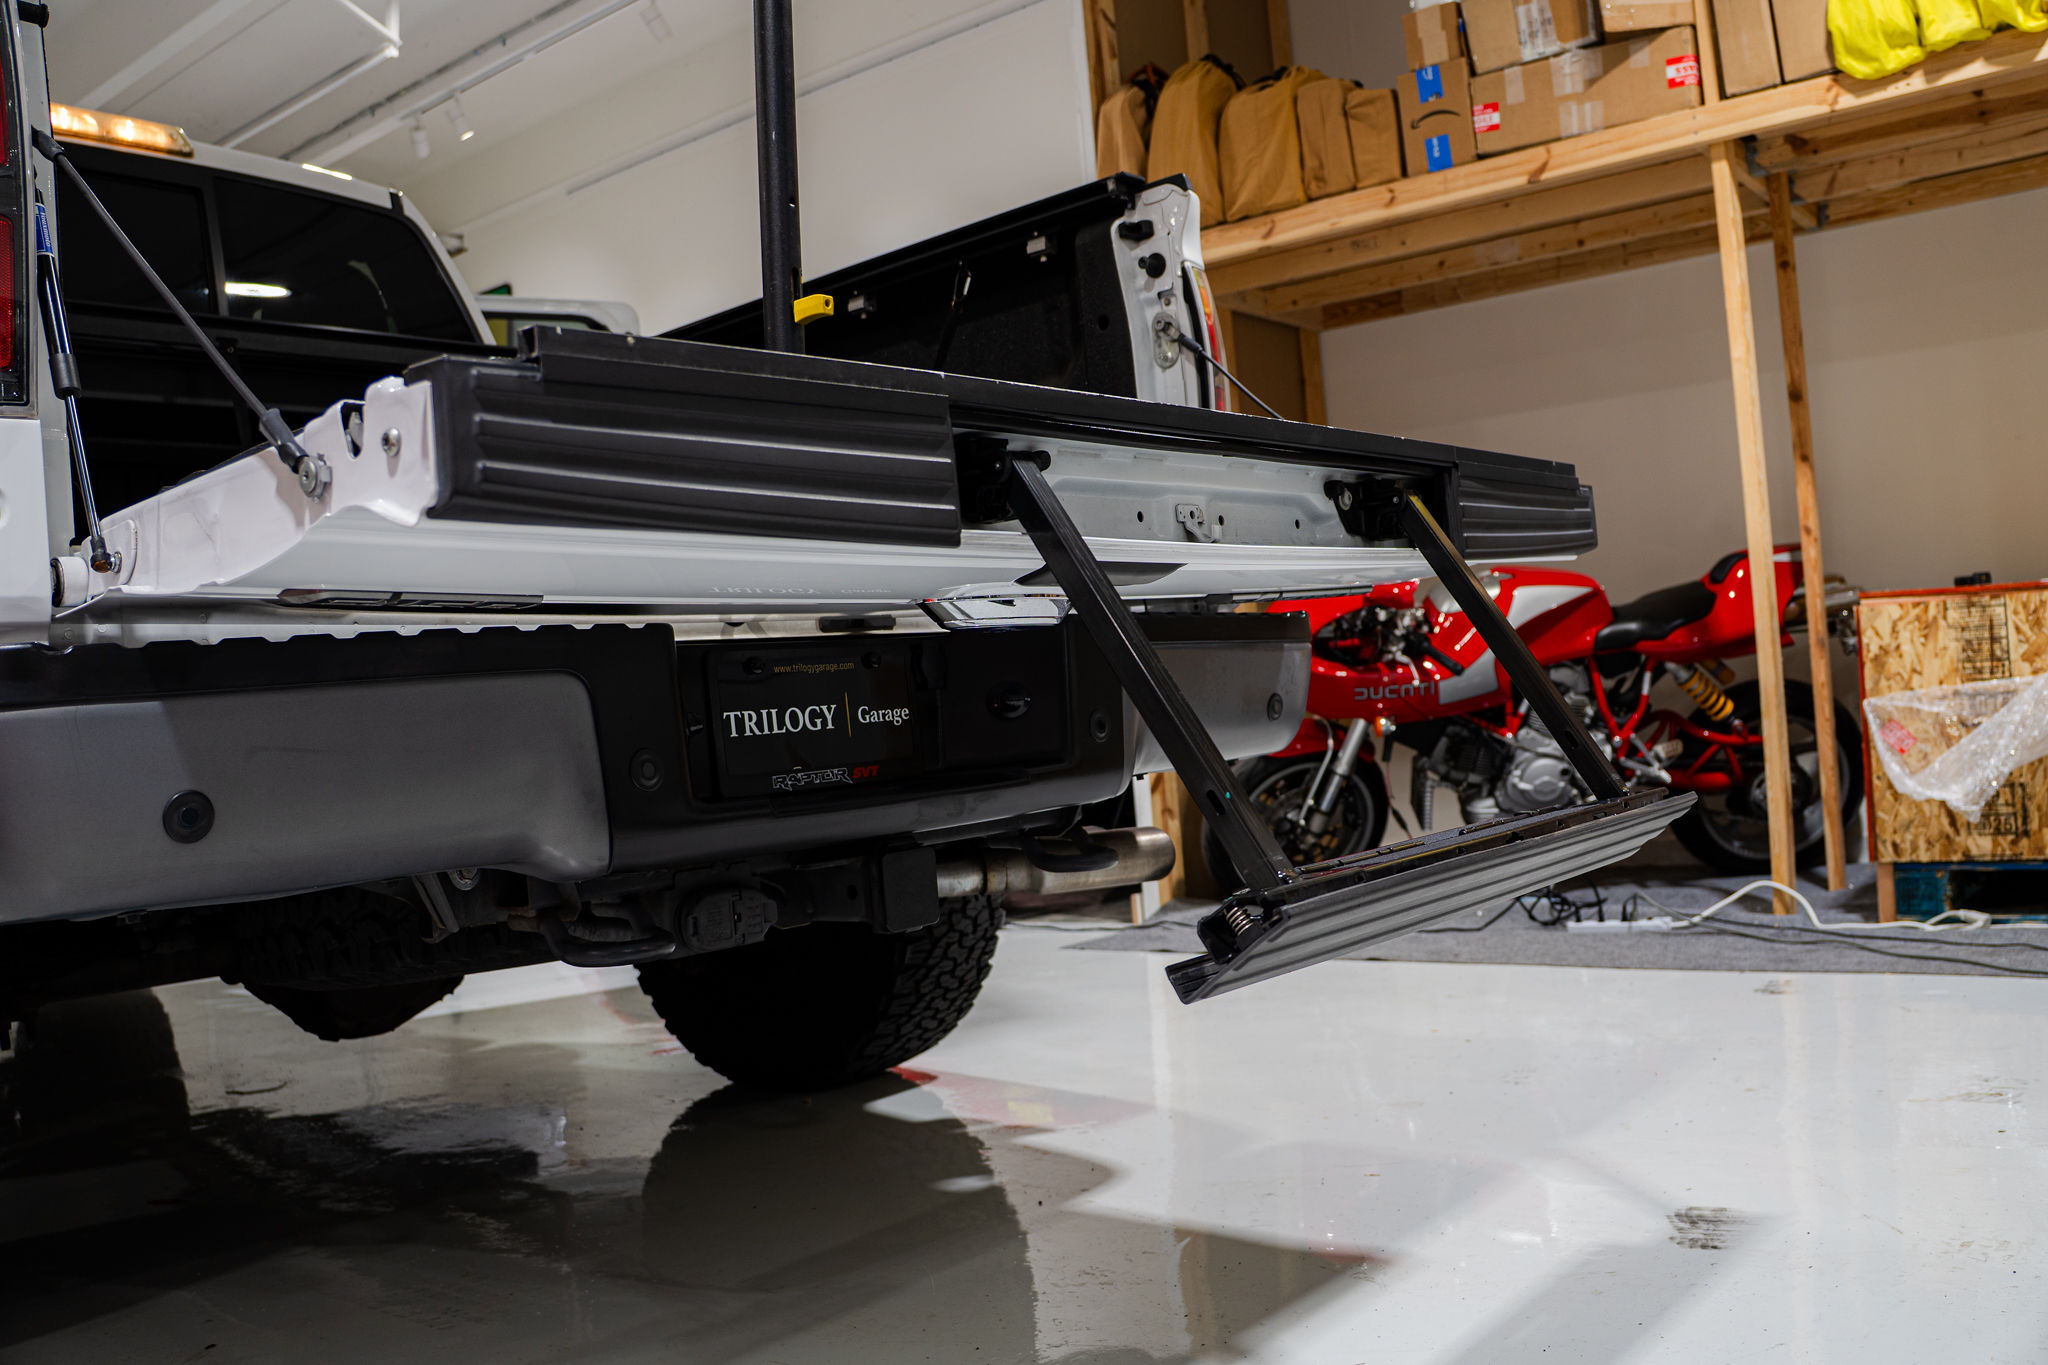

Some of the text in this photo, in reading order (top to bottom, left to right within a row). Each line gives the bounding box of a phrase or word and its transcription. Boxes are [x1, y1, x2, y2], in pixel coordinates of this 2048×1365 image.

[773, 663, 855, 674] www.trilogygarage.com
[1354, 681, 1435, 701] DUCATI
[723, 704, 910, 738] TRILOGY Garage
[772, 765, 879, 791] RAPTOR SVT
